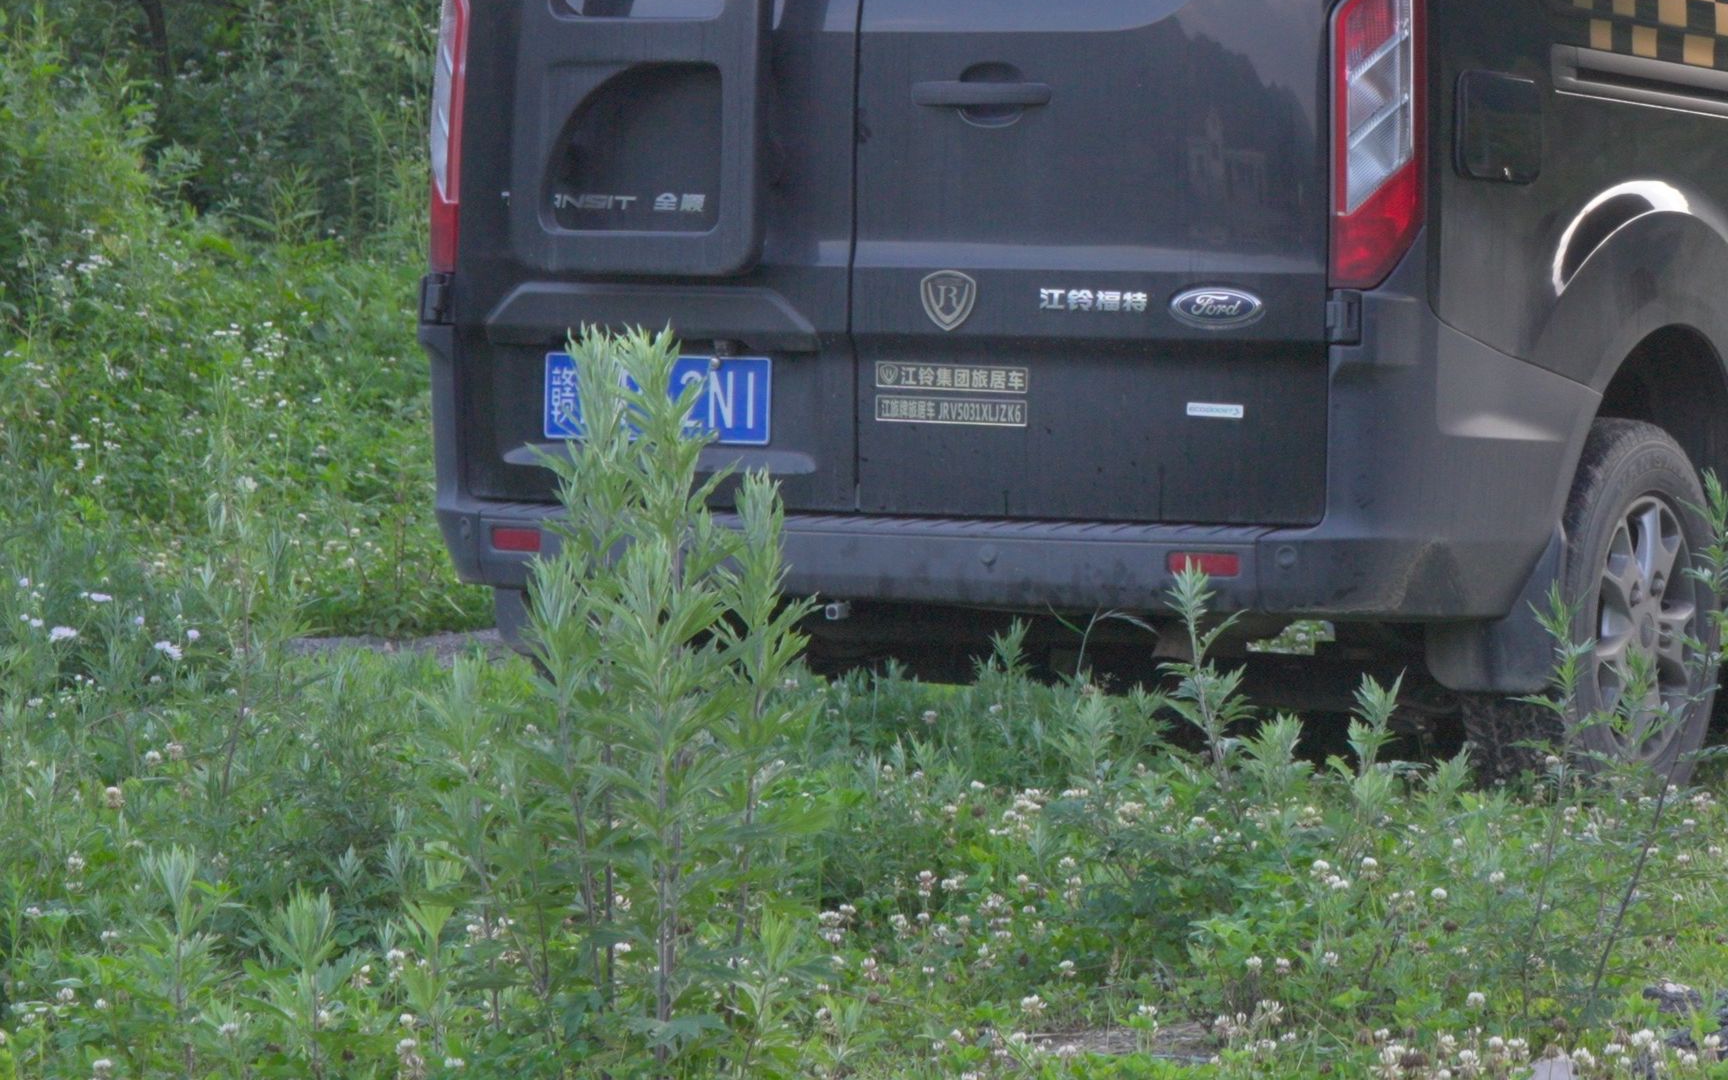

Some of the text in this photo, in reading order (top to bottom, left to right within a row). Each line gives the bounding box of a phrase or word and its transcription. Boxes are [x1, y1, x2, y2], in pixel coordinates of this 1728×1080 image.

[1039, 287, 1148, 312] 江铃福特
[1191, 294, 1242, 316] Ford
[901, 366, 1025, 390] 江铃集团旅居车
